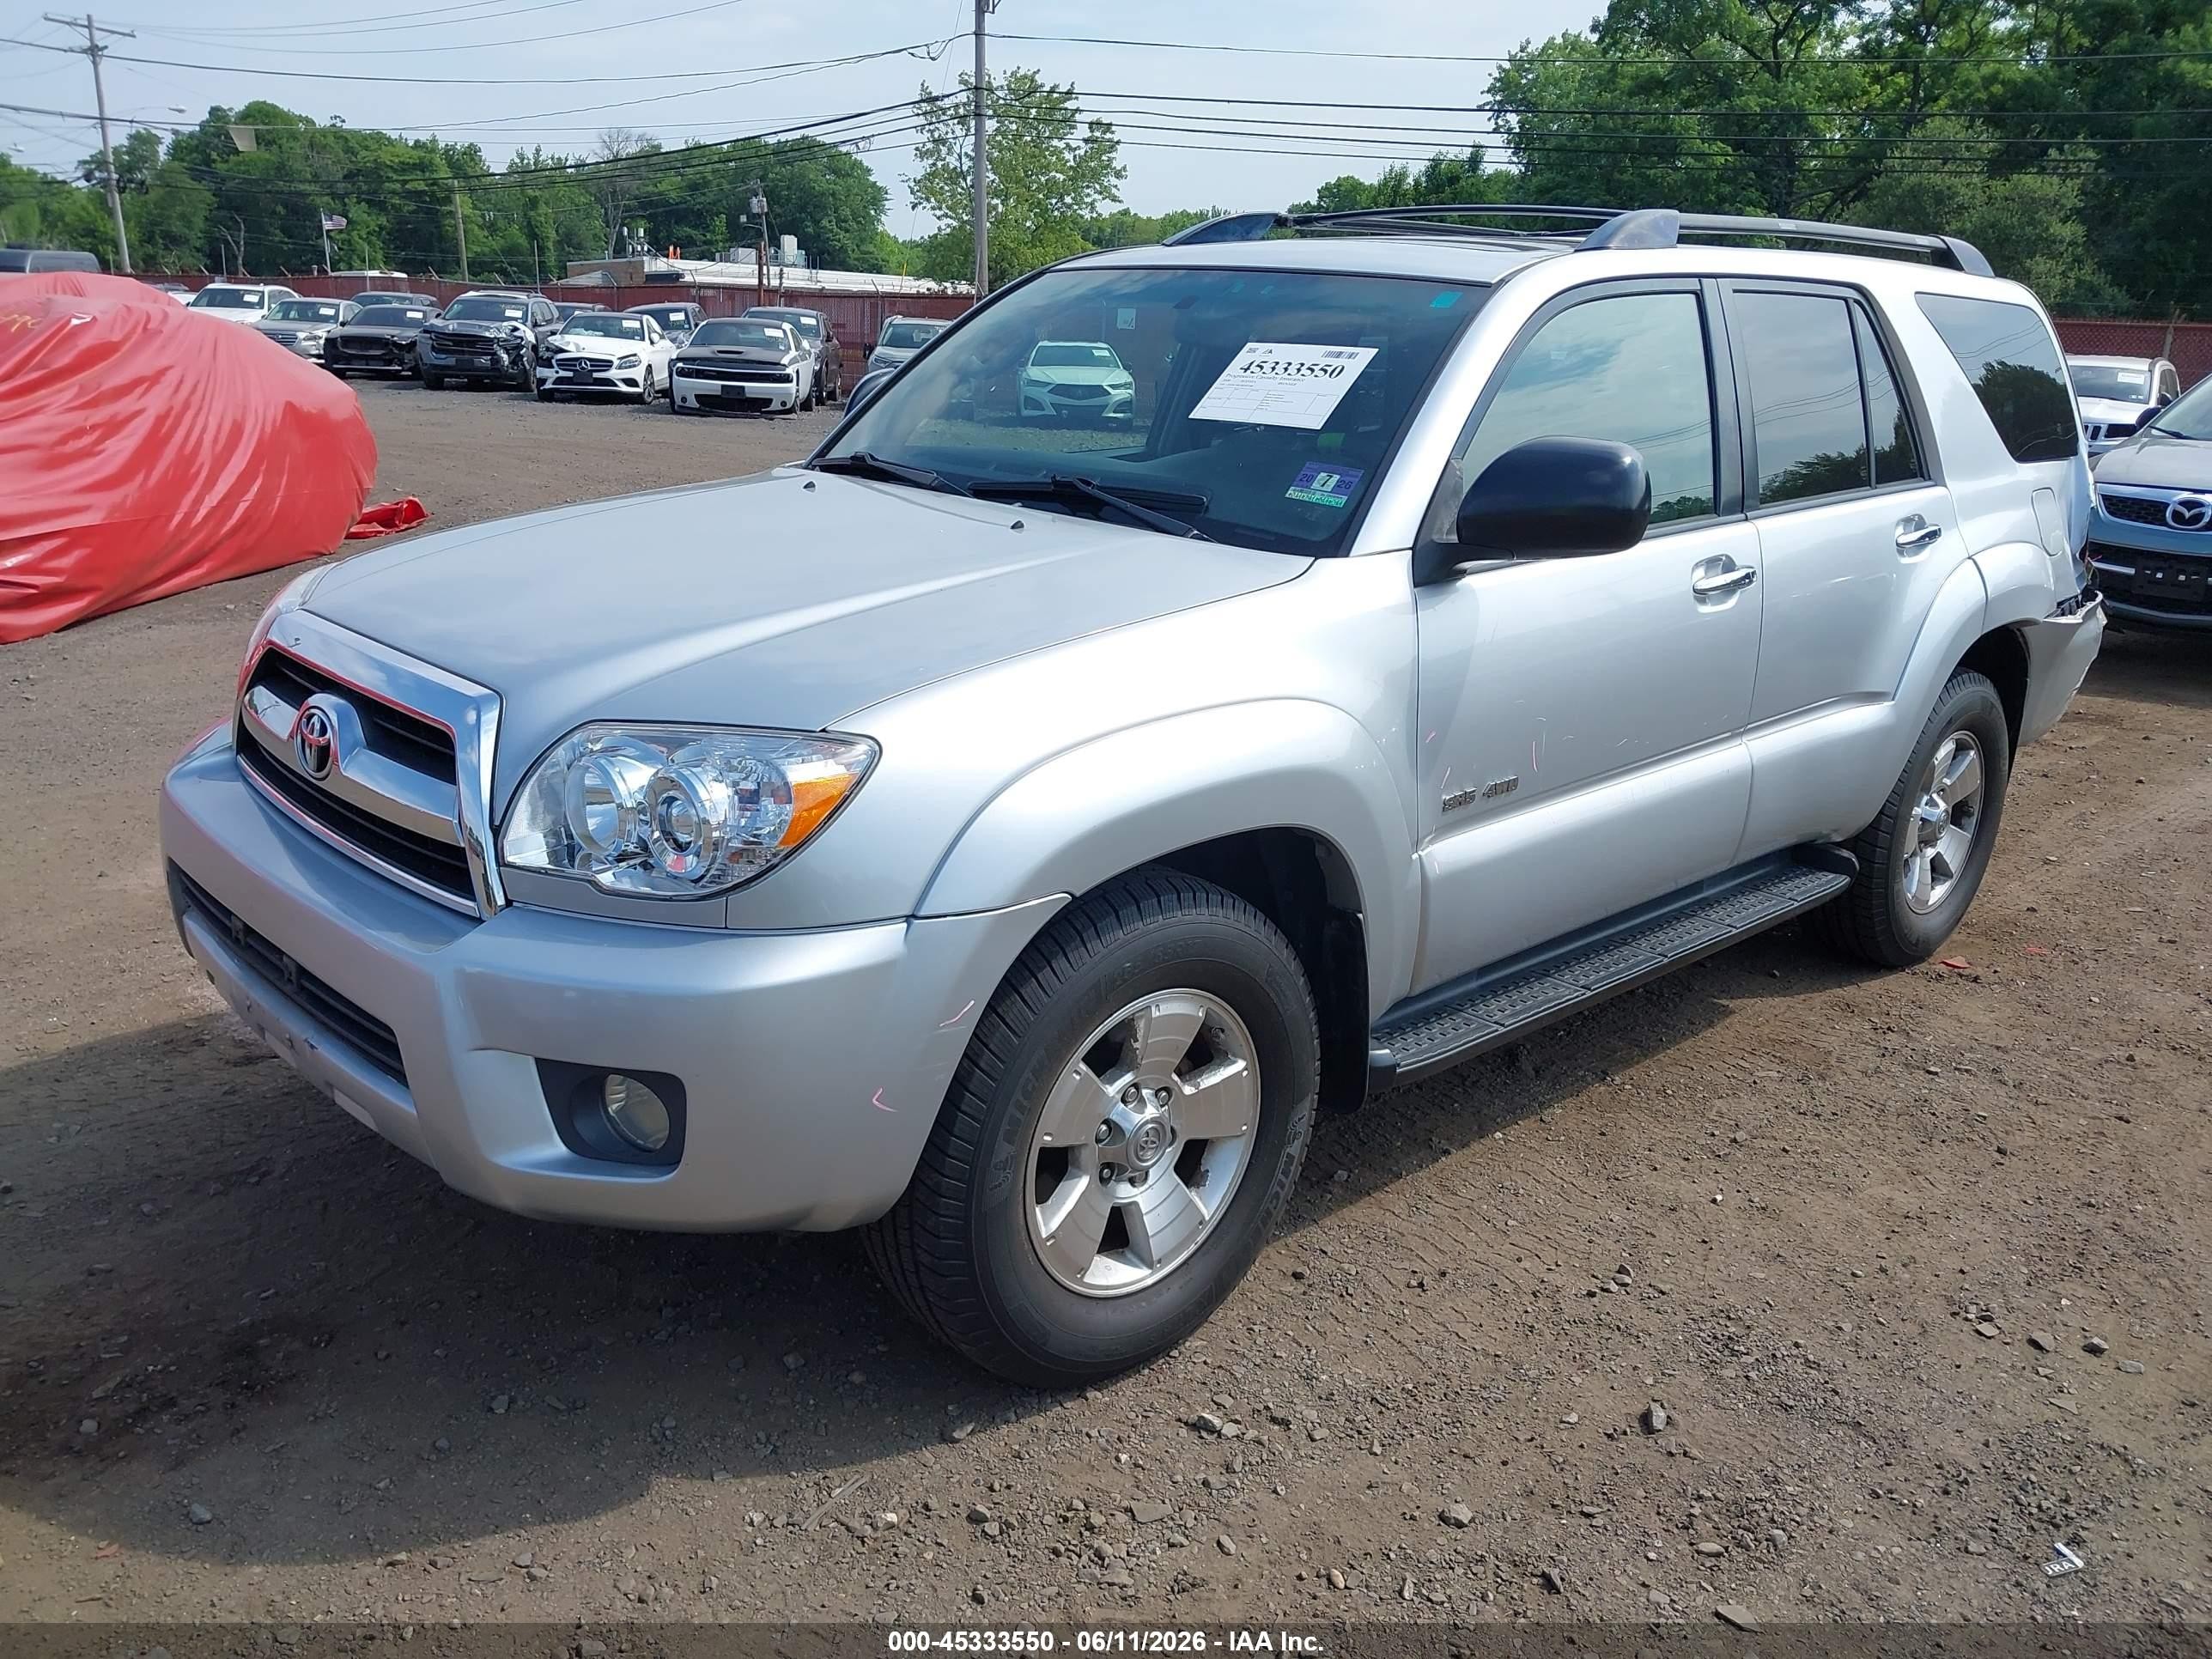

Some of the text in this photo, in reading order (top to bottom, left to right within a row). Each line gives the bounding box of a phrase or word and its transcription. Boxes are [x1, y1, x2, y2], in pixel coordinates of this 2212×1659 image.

[1239, 359, 1346, 380] 45333550
[1299, 473, 1353, 489] 20 7 26
